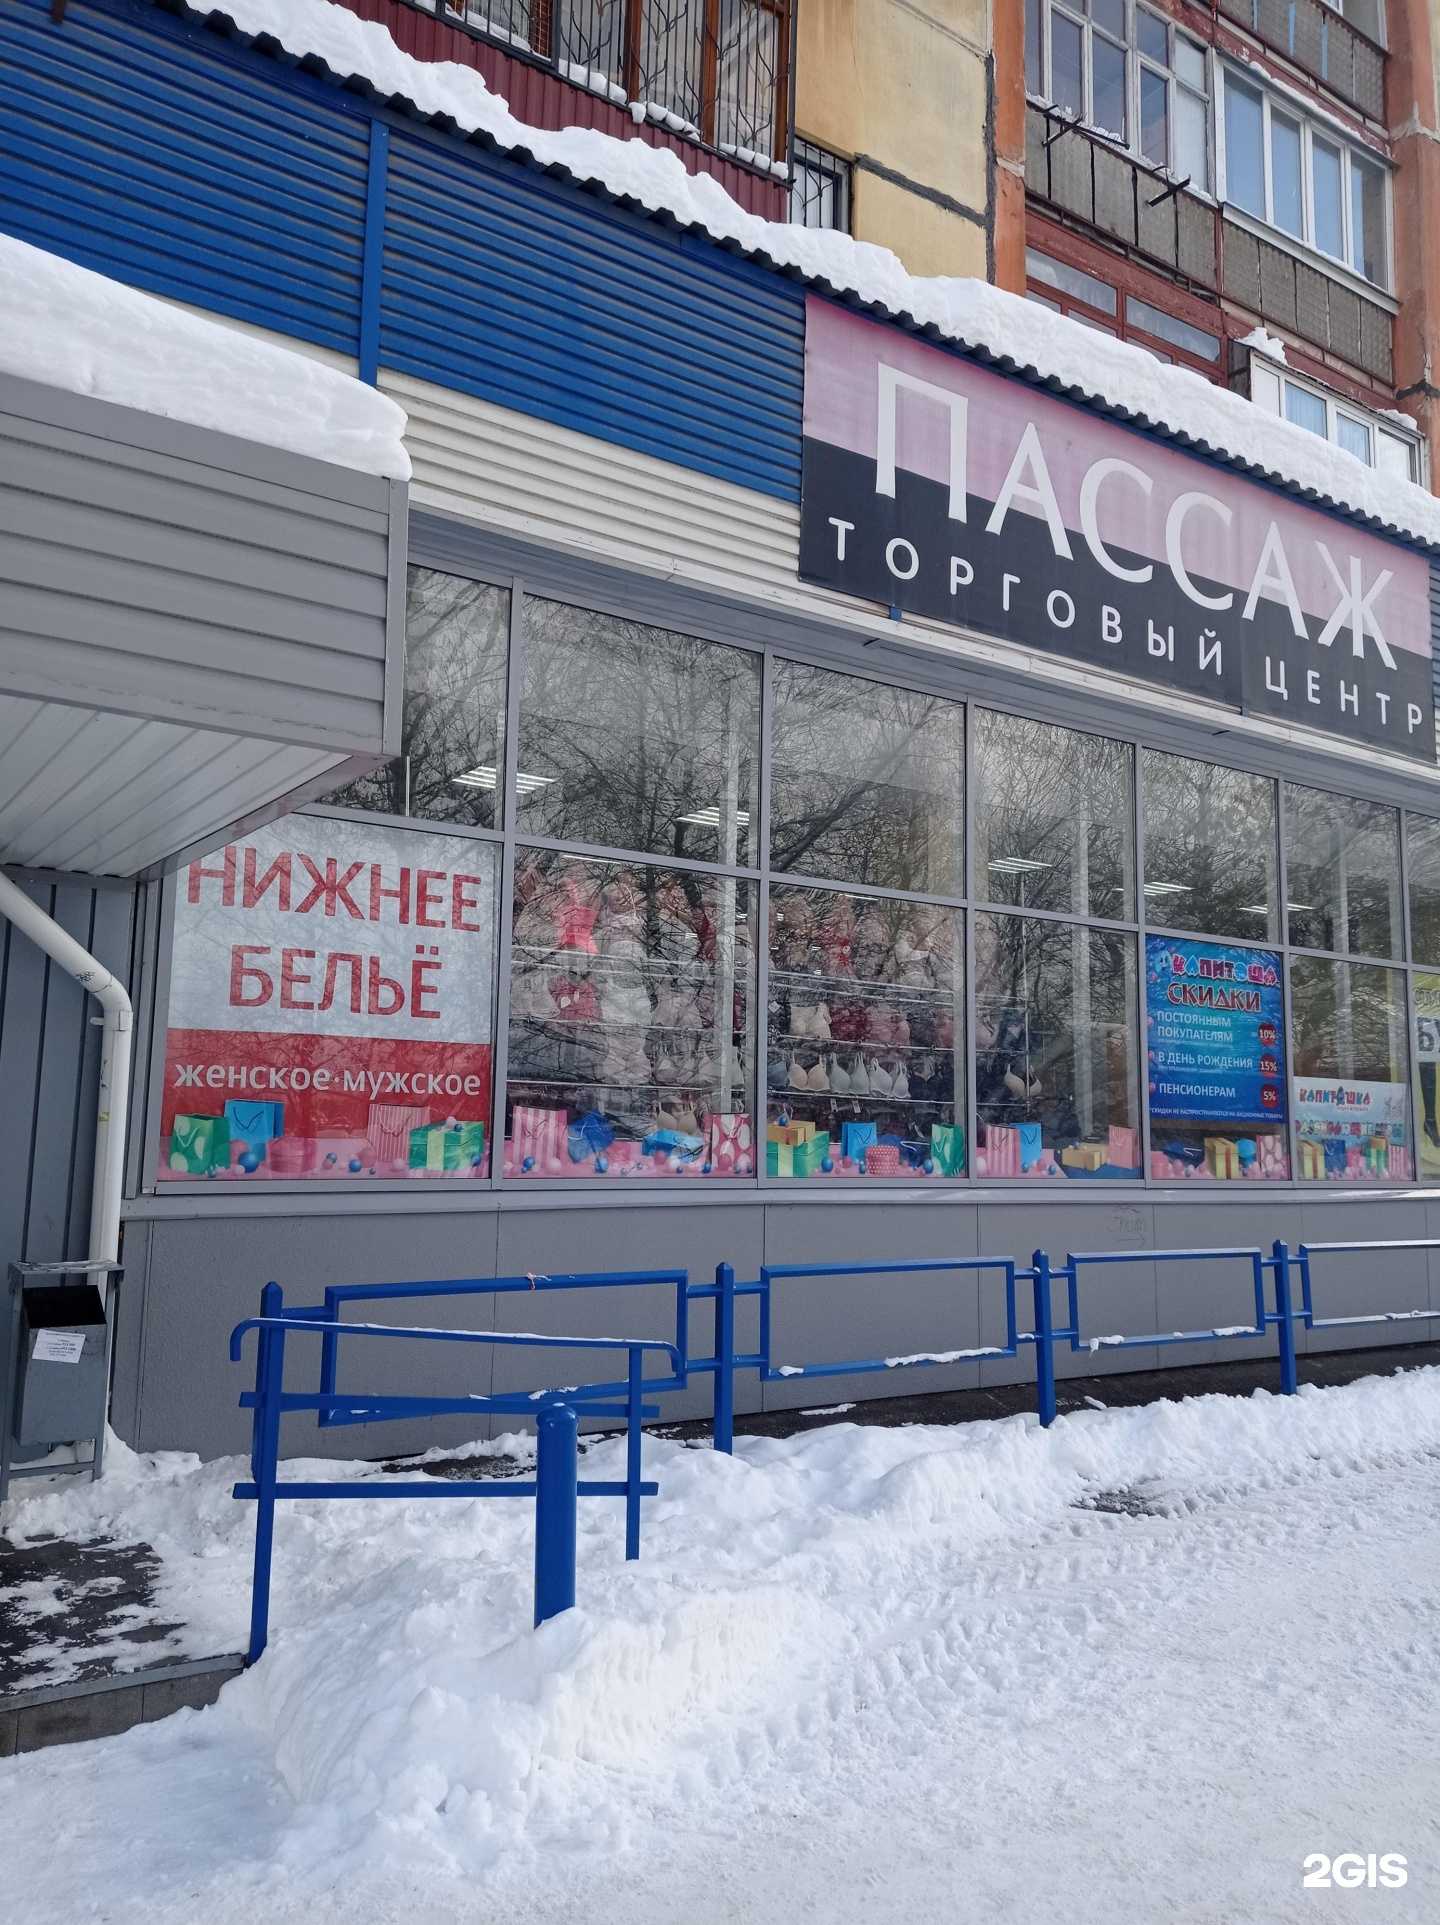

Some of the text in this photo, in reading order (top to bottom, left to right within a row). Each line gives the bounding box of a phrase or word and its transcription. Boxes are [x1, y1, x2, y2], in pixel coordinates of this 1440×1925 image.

[876, 361, 1398, 671] ПАССАЖ
[828, 516, 1423, 735] ТОРГОВЫЙ ЦЕНТР
[187, 845, 481, 932] НИЖНЕЕ
[229, 944, 443, 1019] БЕЛЬЁ
[1167, 981, 1262, 1013] СКИДКИ
[1156, 1010, 1232, 1028] ПОСТОЯННЫМ
[1157, 1025, 1276, 1042] ПОКУПАТЕЛЯМ 10%
[1158, 1051, 1165, 1062] В
[1167, 1051, 1196, 1065] ДЕНЬ
[1197, 1054, 1253, 1069] РОЖДЕНИЯ
[1260, 1061, 1278, 1072] 15%
[1158, 1082, 1276, 1101] ПЕНСИОНЕРАМ 5%
